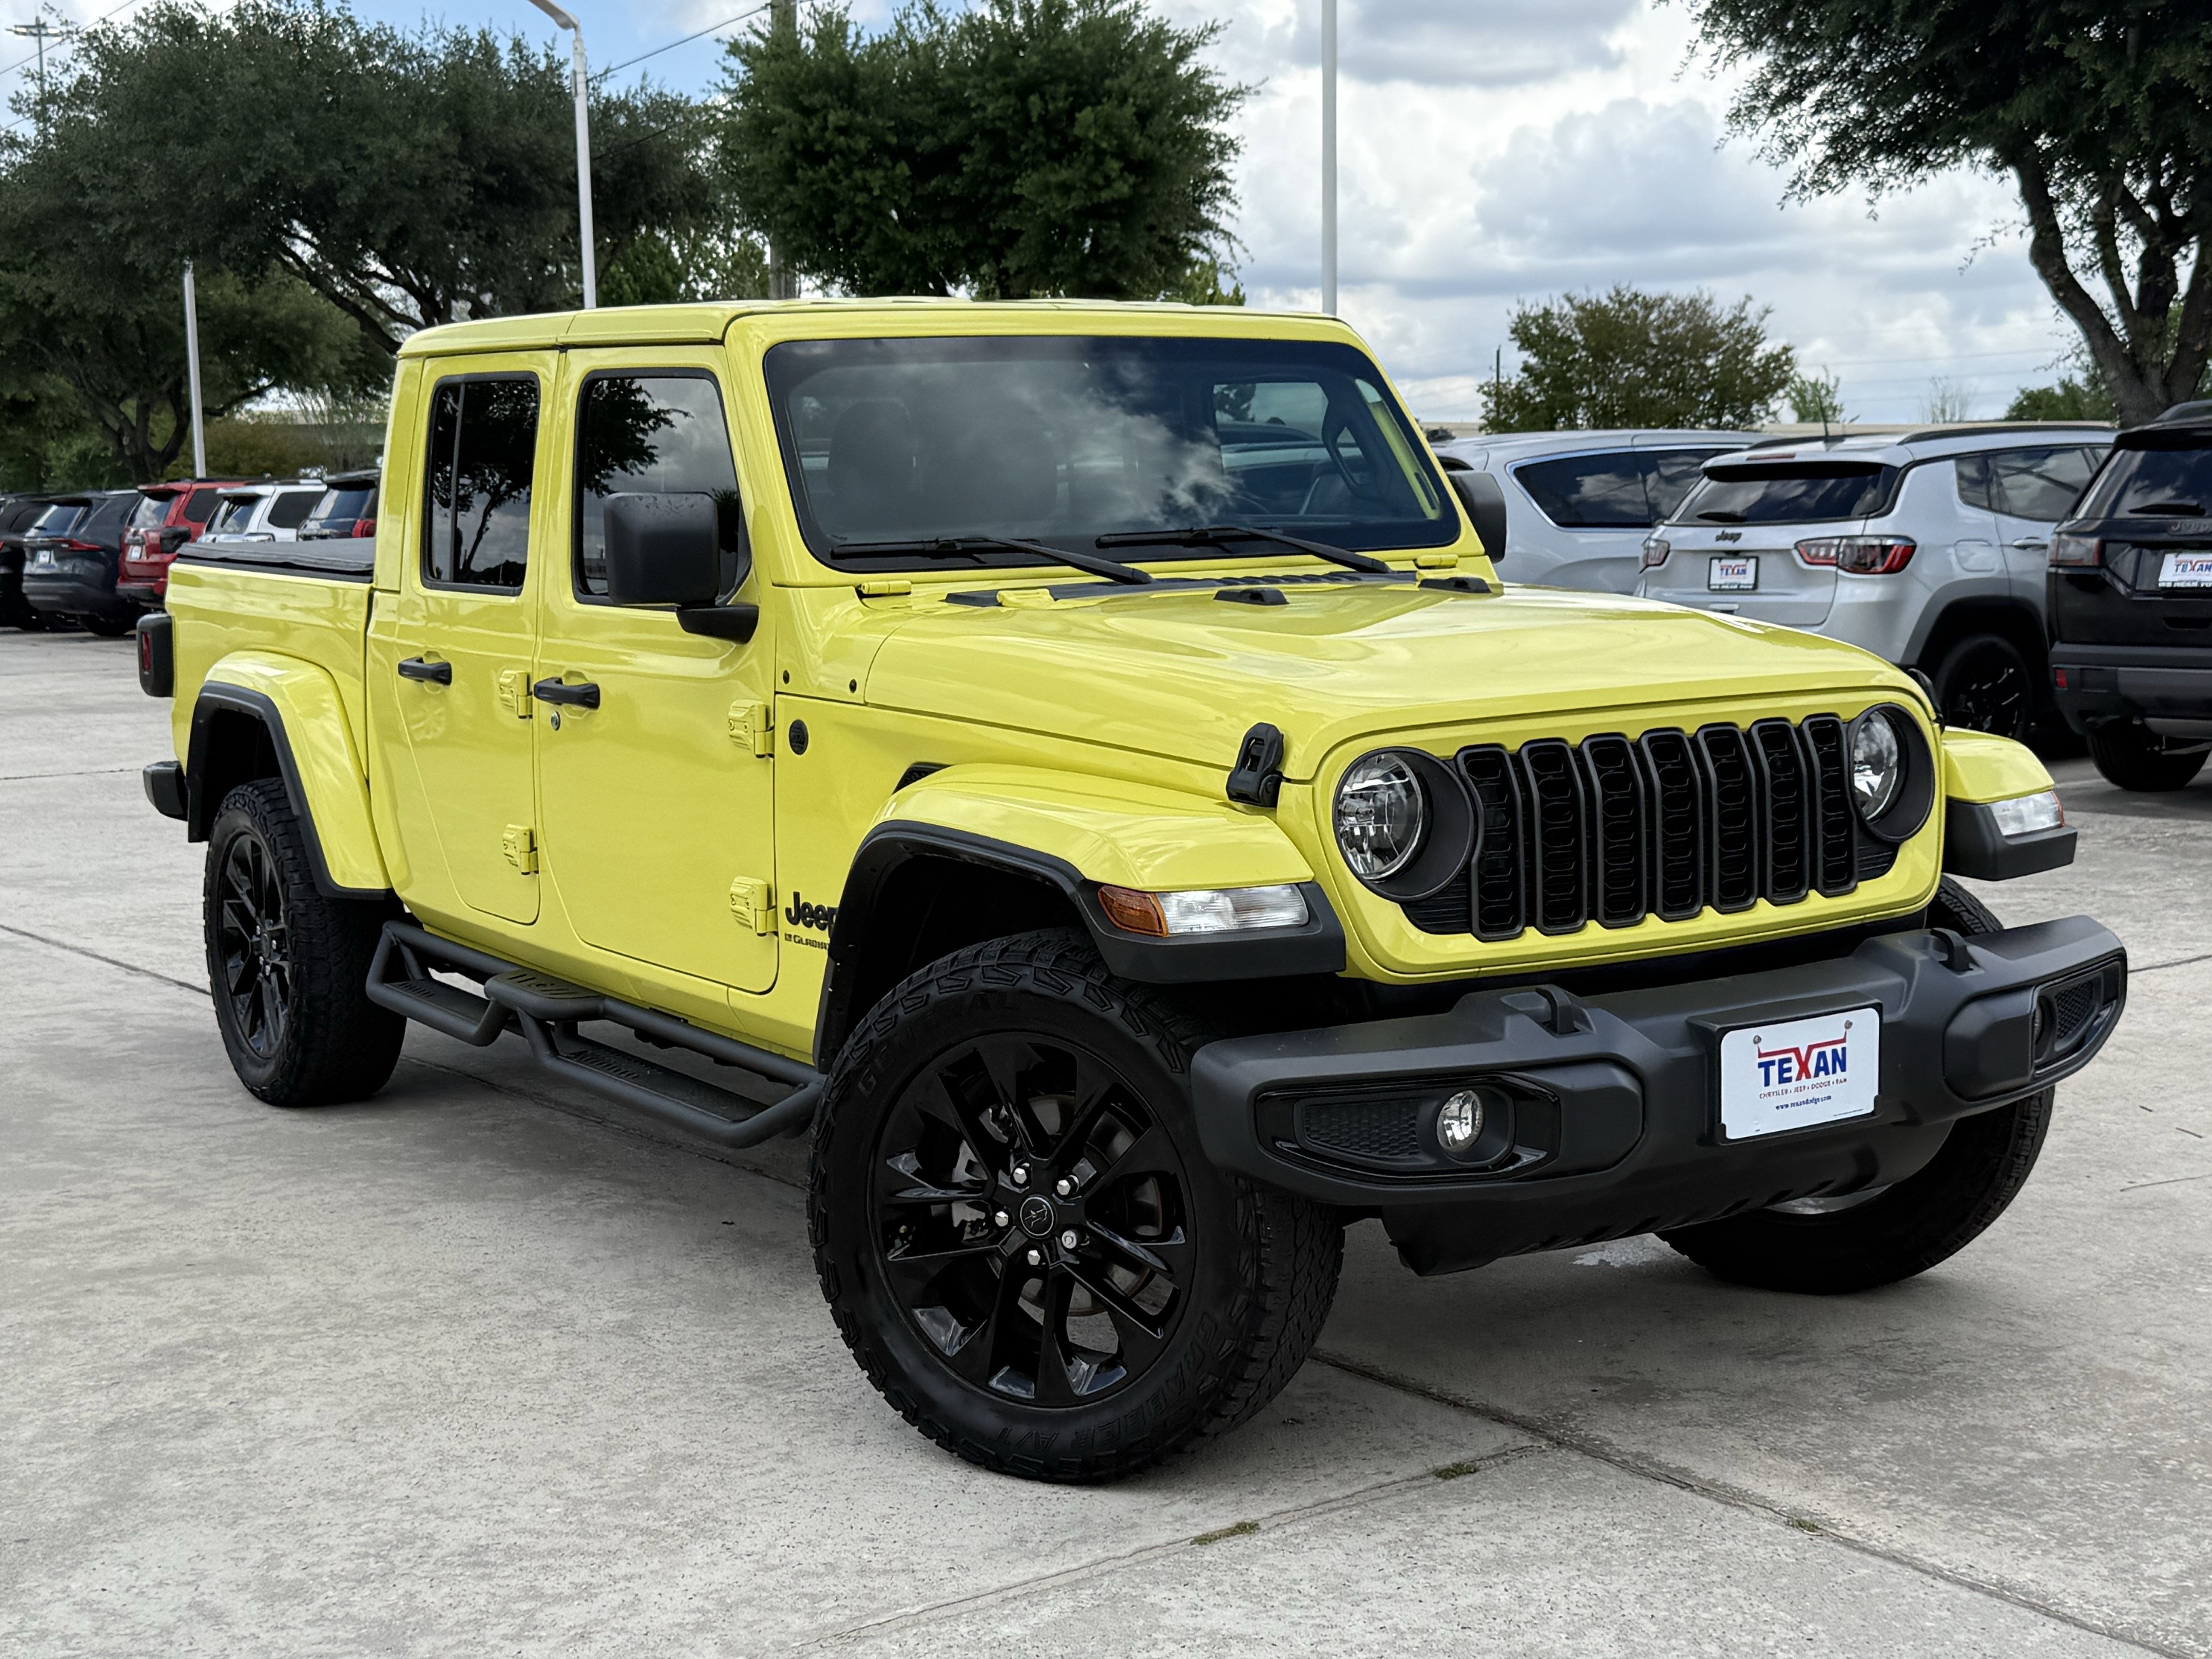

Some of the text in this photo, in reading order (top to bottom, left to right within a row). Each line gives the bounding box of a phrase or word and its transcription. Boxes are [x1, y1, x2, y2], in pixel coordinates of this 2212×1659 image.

[1716, 530, 1742, 543] Jeep
[1757, 1042, 1847, 1087] TEXAN
[1759, 1089, 1788, 1099] CHRYSLER
[1811, 1080, 1831, 1090] DODGE
